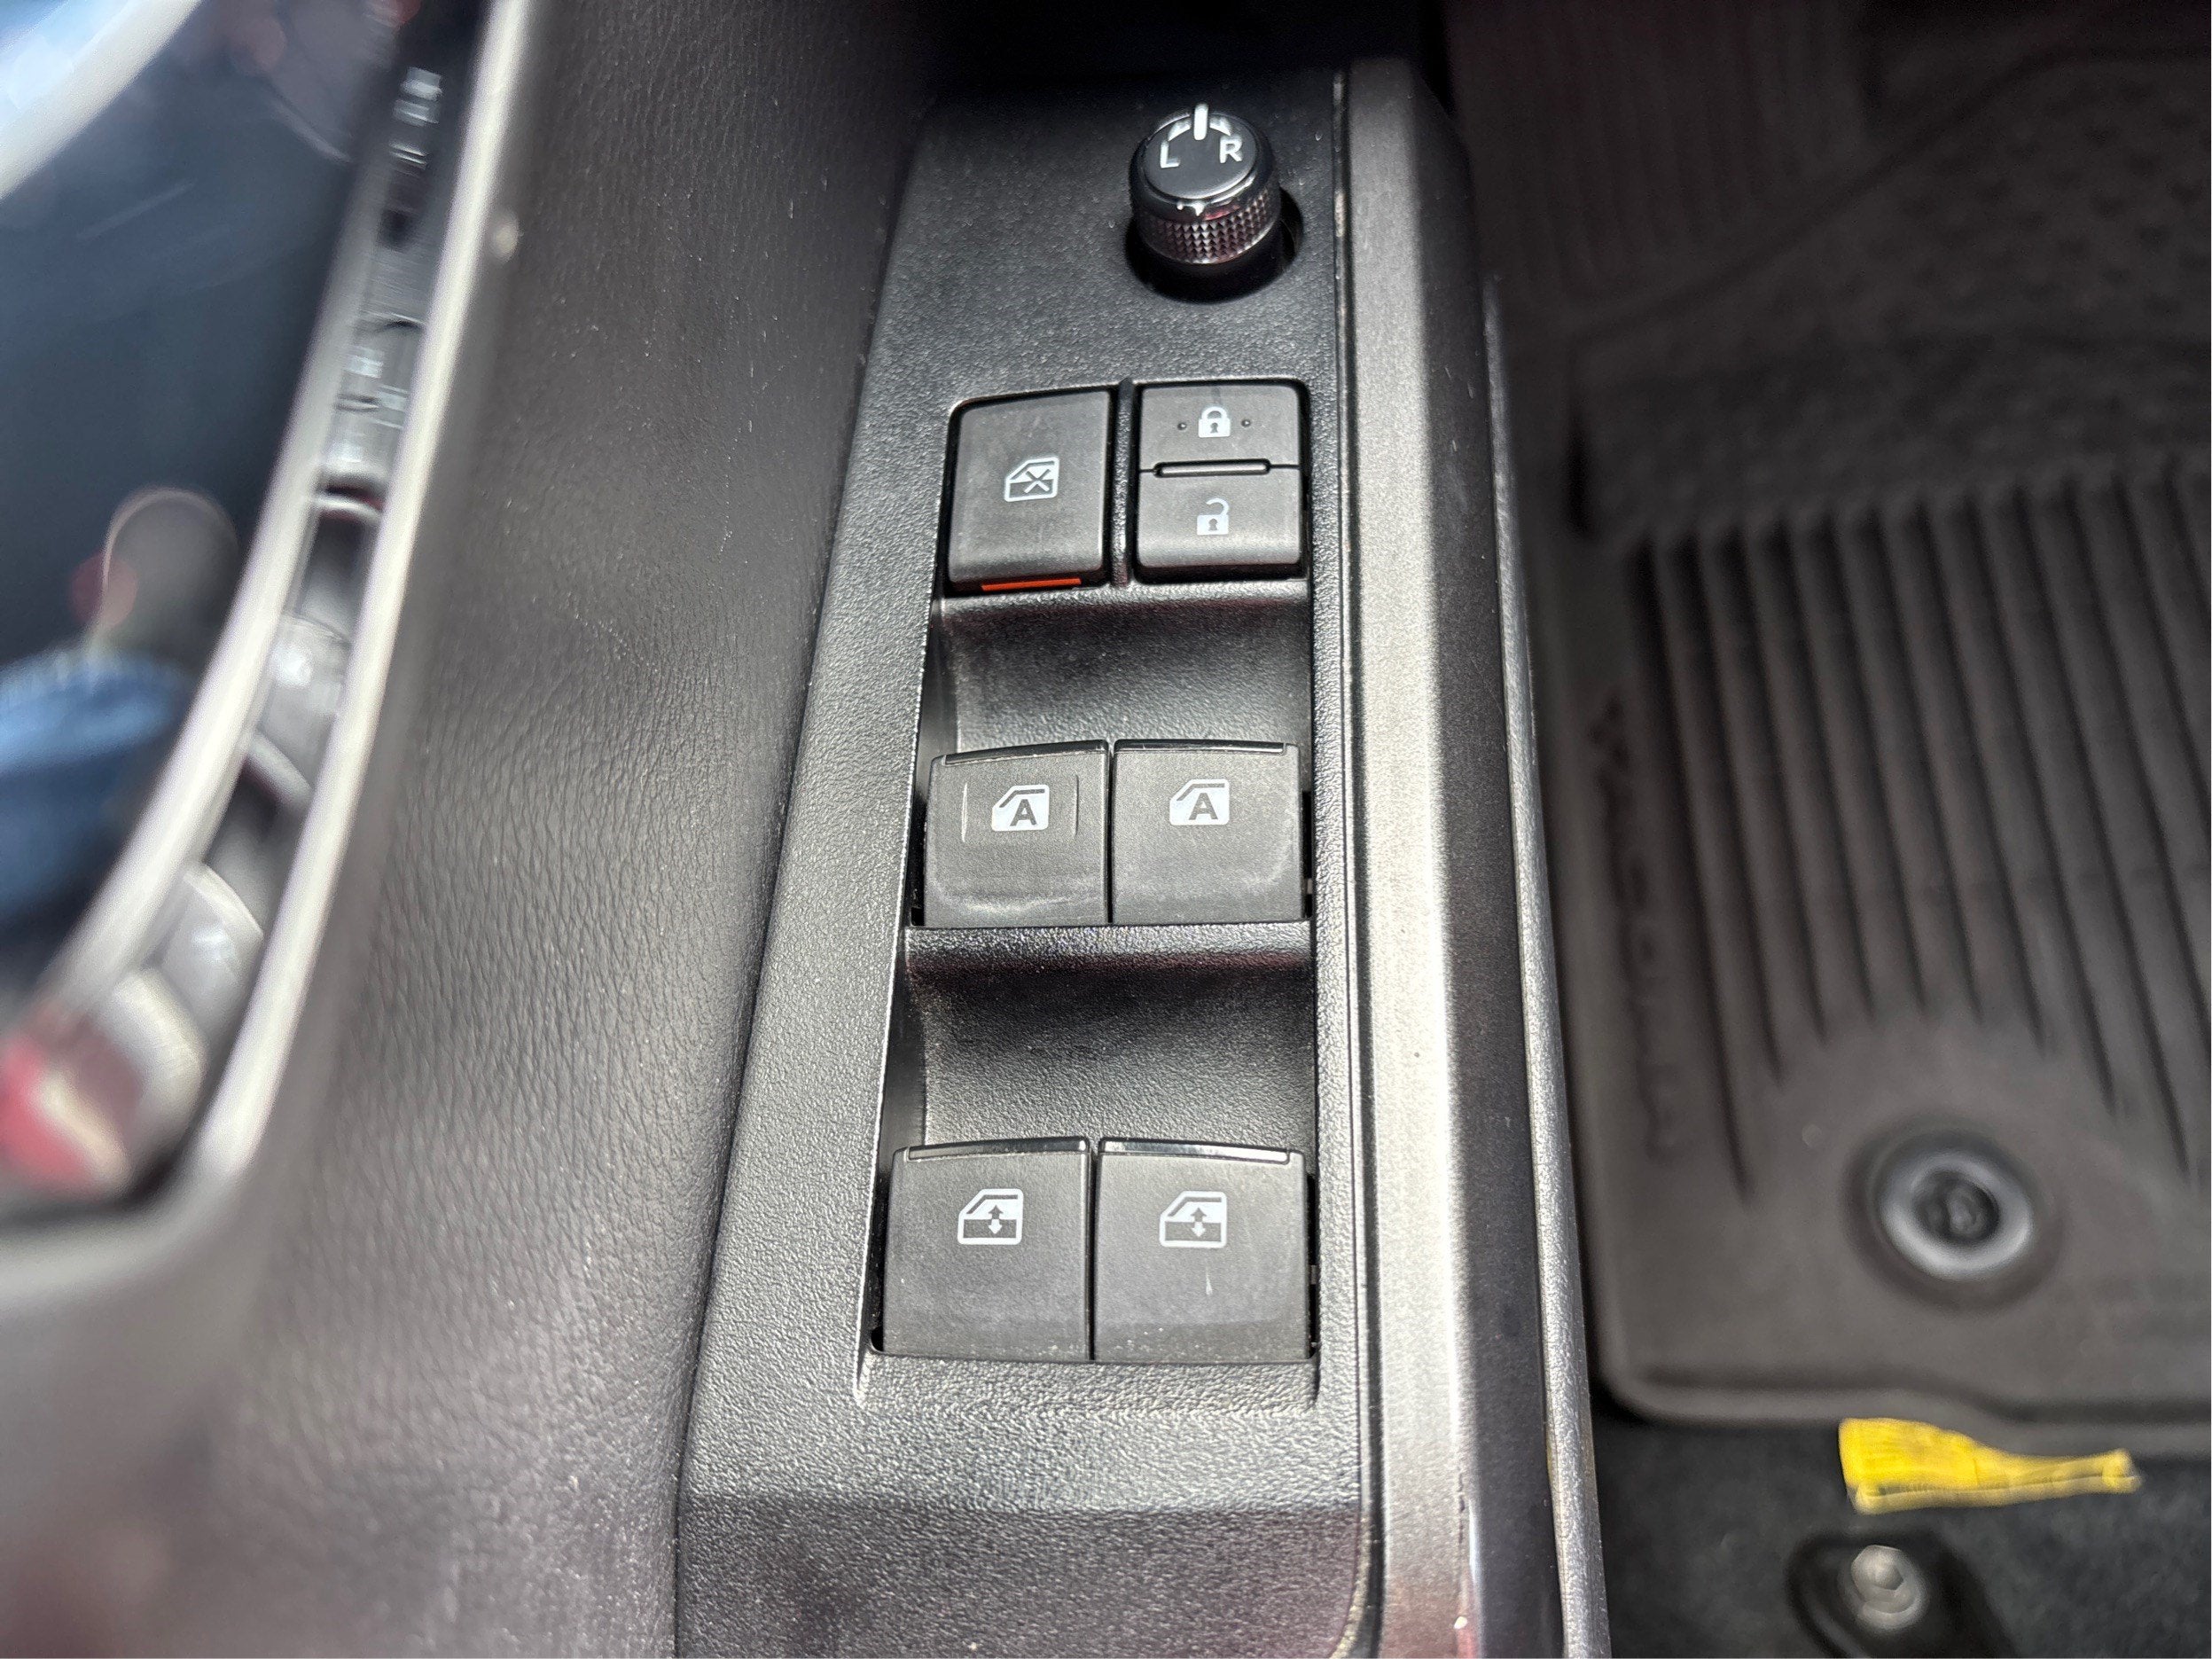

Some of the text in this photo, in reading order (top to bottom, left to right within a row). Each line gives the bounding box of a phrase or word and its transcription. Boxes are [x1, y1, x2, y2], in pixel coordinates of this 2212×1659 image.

[1160, 134, 1243, 168] L R
[1010, 799, 1037, 827] A
[1188, 792, 1218, 821] A
